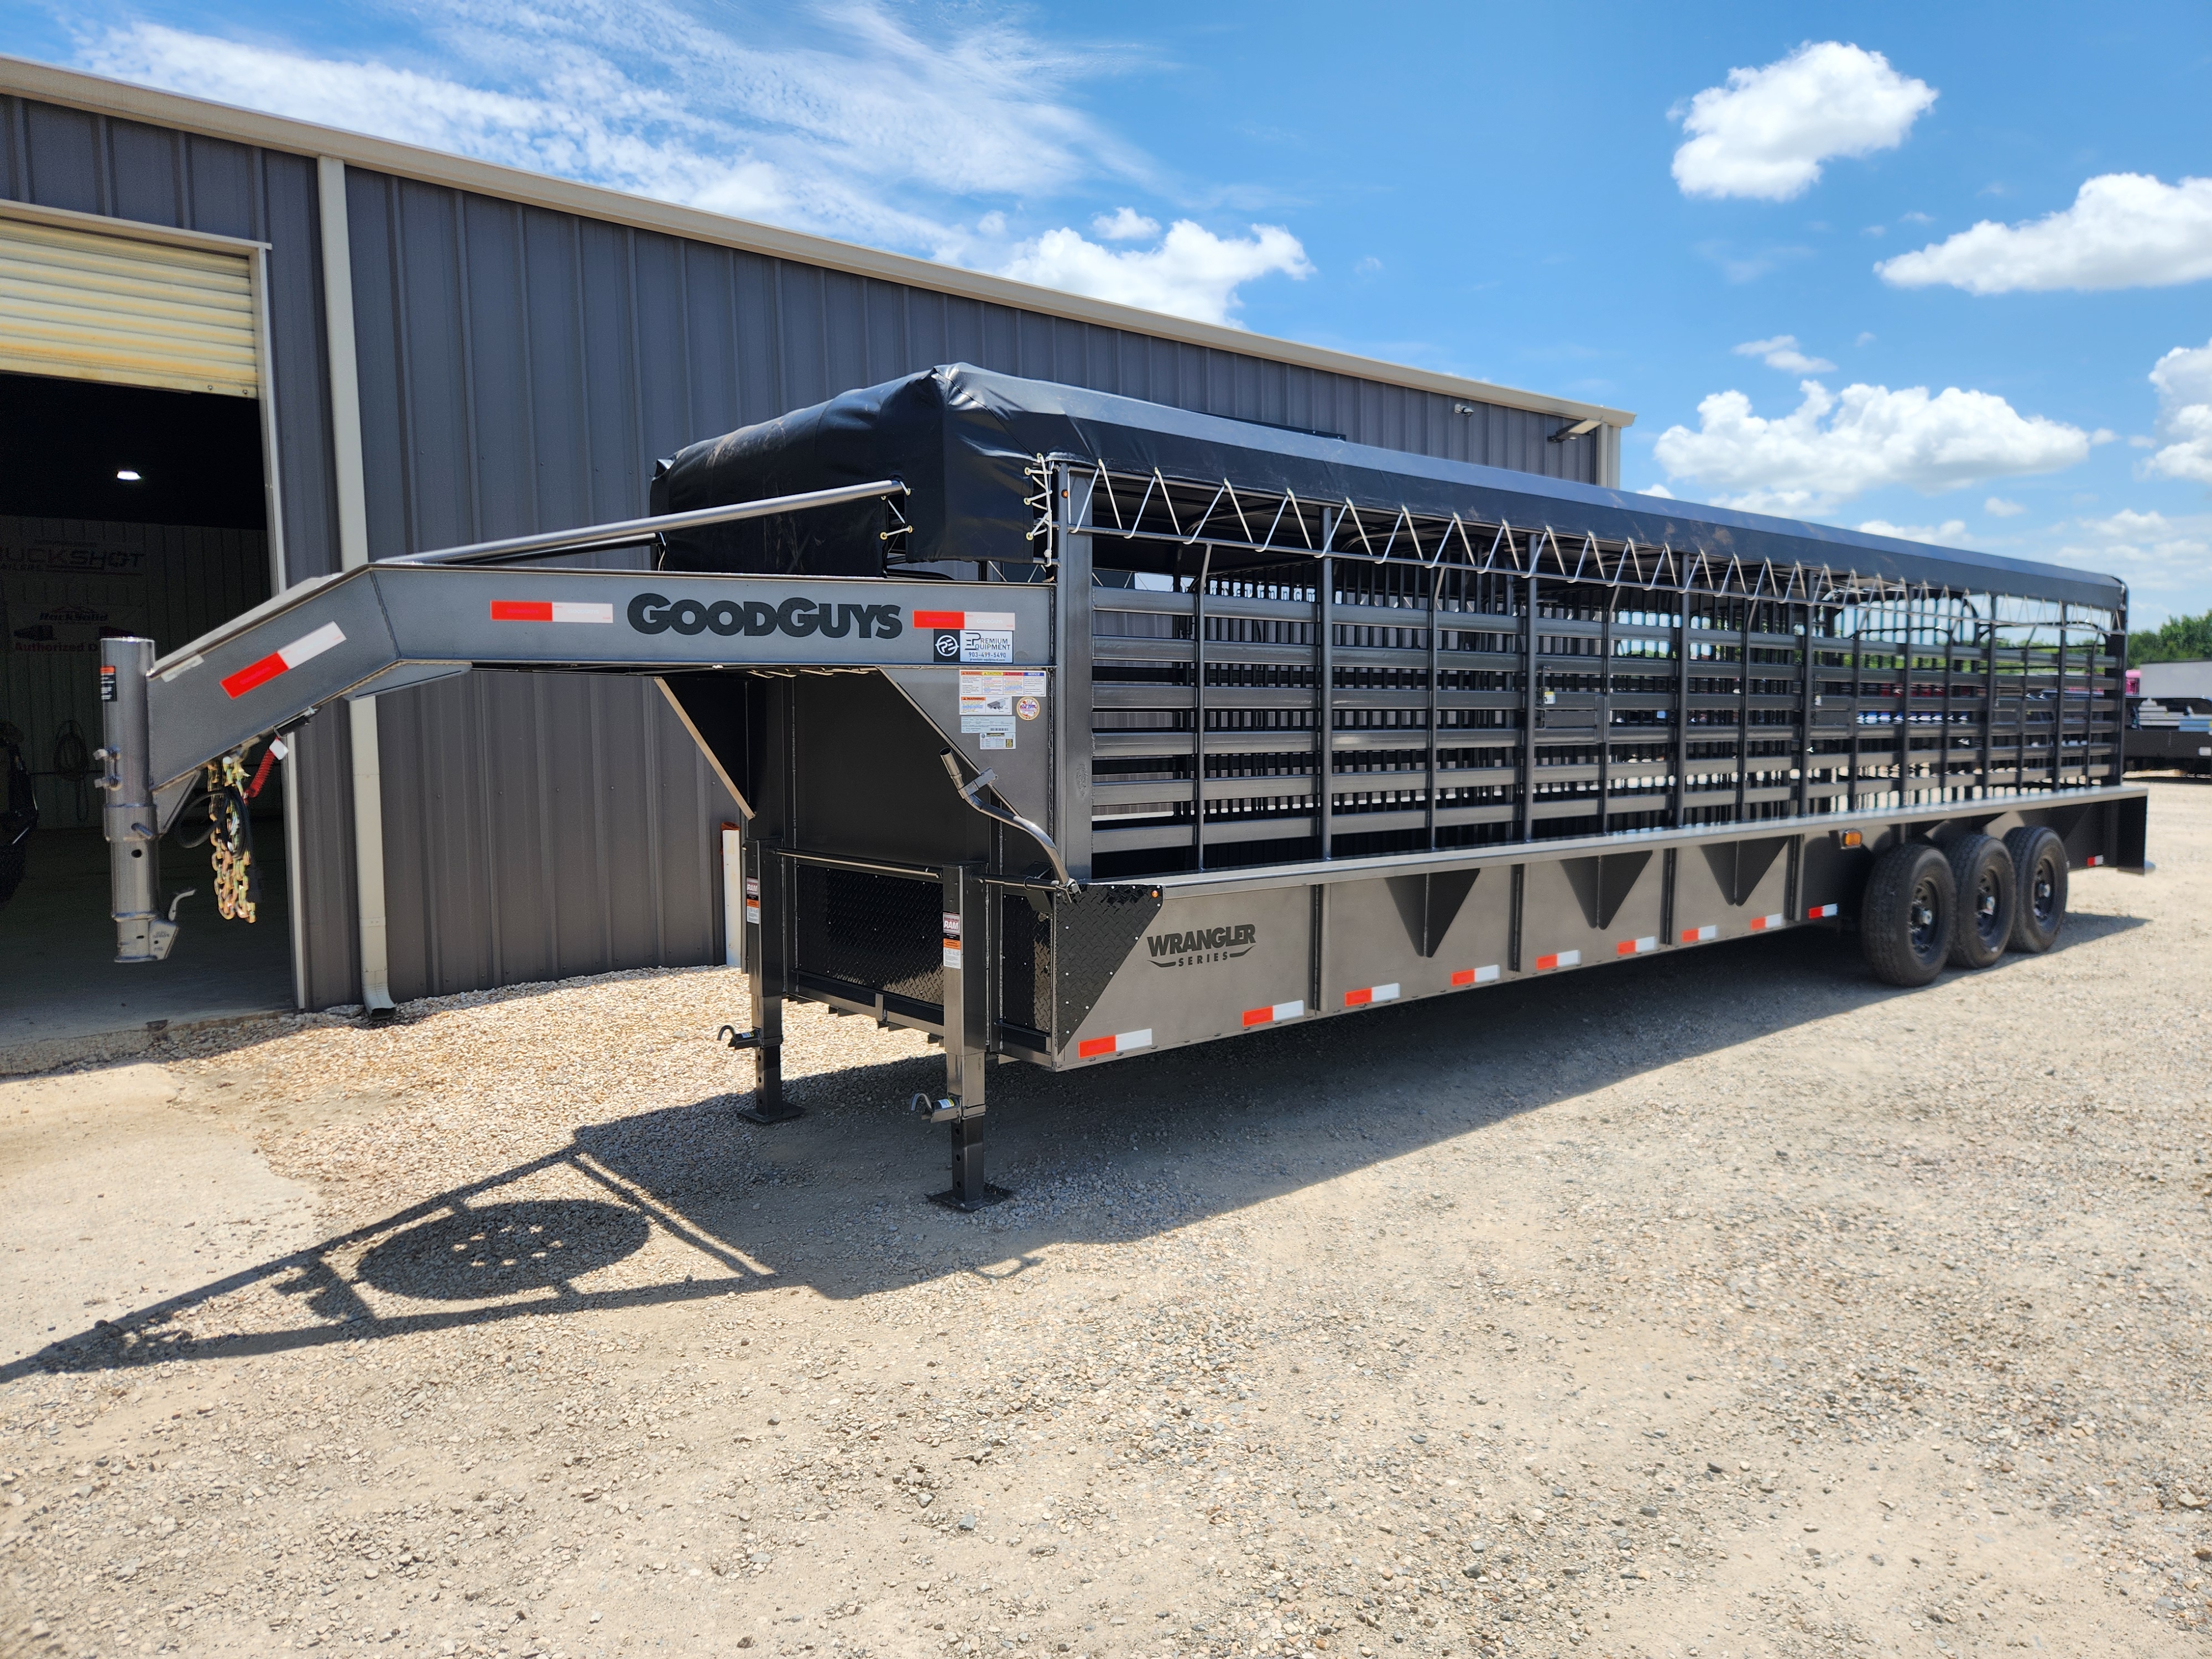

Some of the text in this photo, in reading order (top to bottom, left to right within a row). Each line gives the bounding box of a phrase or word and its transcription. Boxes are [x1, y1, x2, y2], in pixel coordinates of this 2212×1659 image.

[627, 593, 902, 639] GOODGUYS
[944, 920, 959, 930] RAM
[1147, 924, 1256, 957] WRANGLER
[1178, 952, 1228, 967] SERIES
